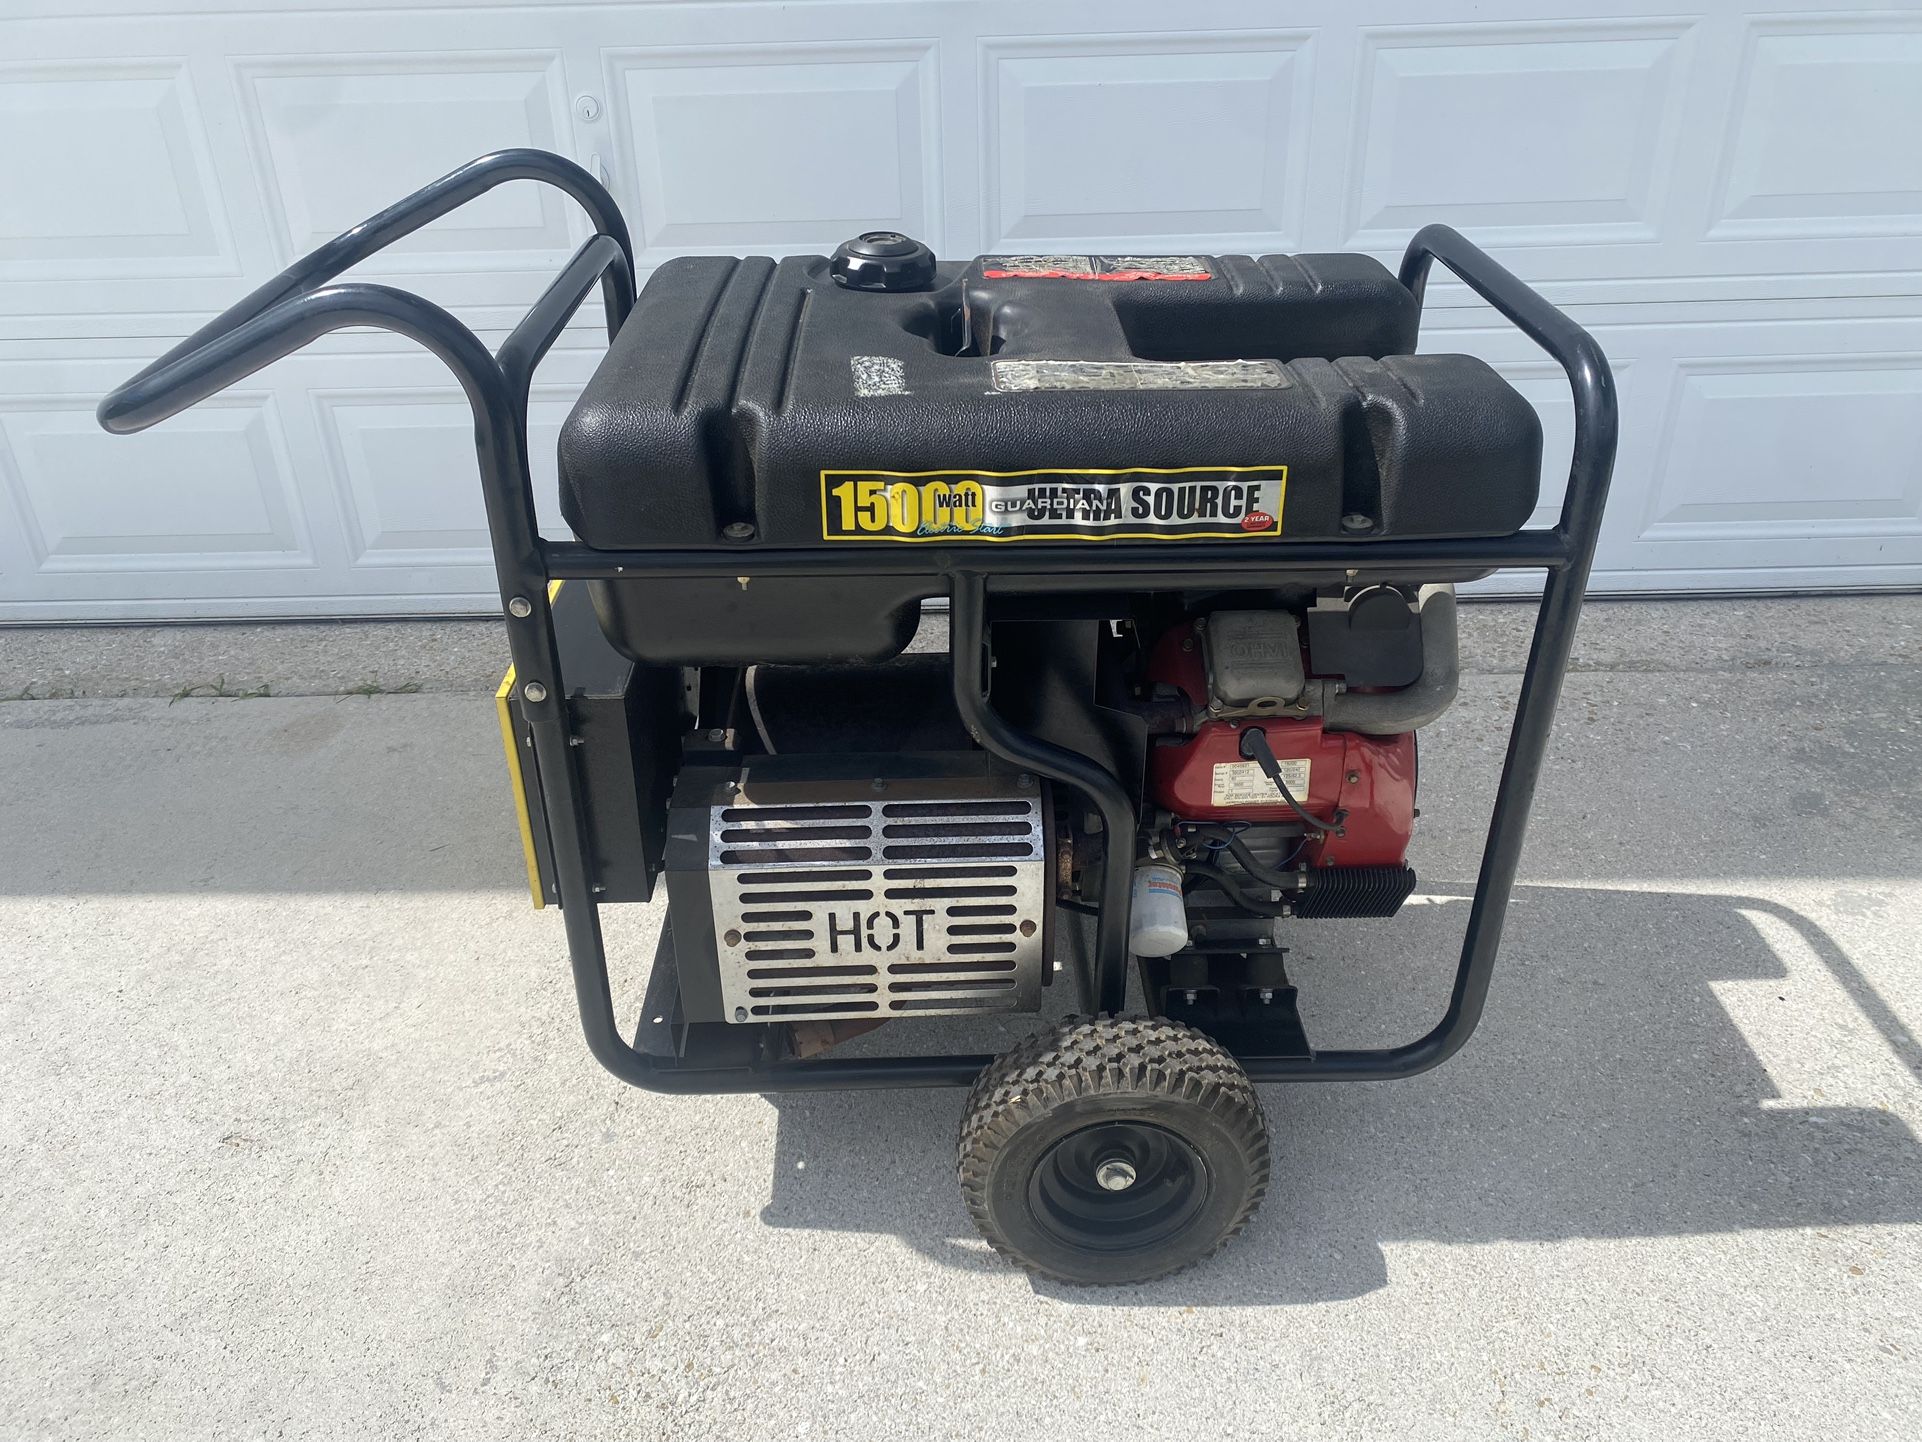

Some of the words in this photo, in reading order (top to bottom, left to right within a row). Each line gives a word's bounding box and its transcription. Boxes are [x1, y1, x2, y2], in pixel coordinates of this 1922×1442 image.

[832, 480, 984, 533] 15000
[937, 491, 977, 508] watt
[991, 498, 1108, 512] GUARDIAN
[1026, 487, 1123, 522] ULTRA
[1131, 484, 1261, 520] SOURCE
[969, 518, 1004, 535] Start
[828, 910, 935, 953] HOT
